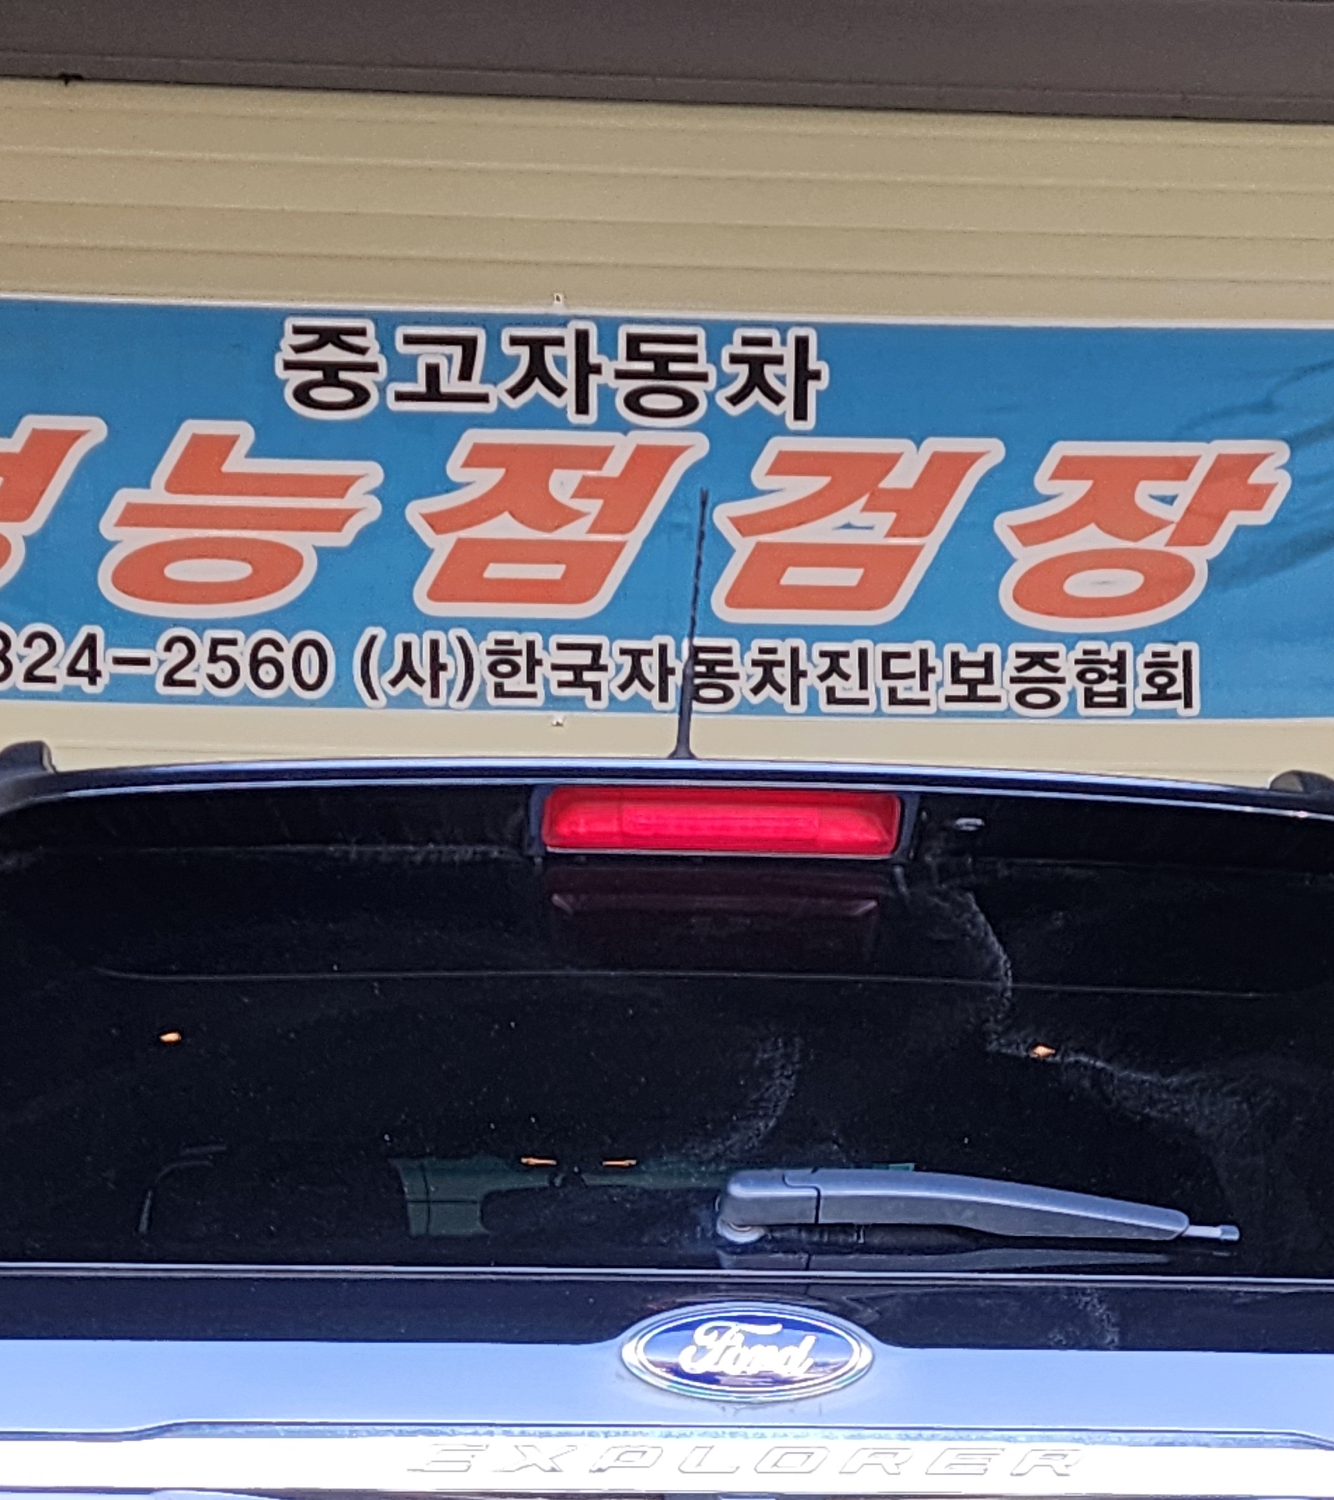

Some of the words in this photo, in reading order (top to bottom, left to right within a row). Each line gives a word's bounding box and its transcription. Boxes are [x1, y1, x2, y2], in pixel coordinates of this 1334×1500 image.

[282, 324, 822, 421] 중고자동차
[359, 634, 1194, 711] (사)한국자동차진단보증협회
[677, 1320, 817, 1376] Ford
[407, 1442, 1087, 1478] EXPLORER
